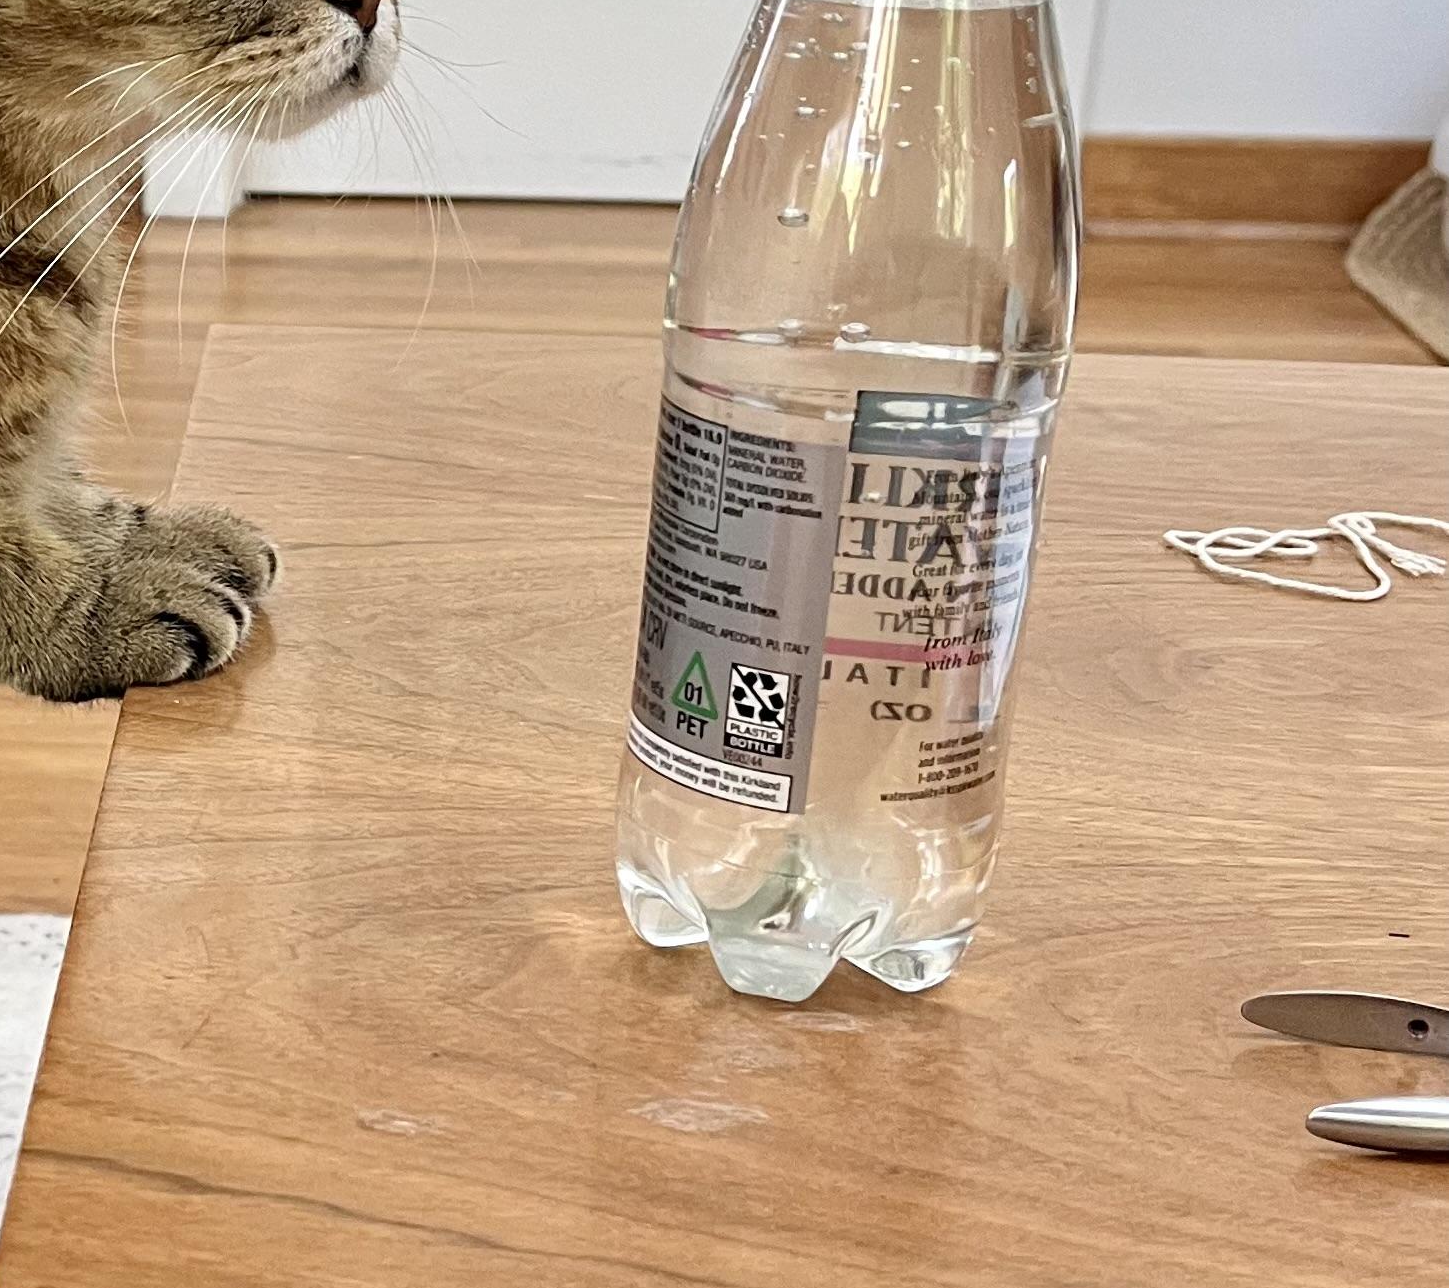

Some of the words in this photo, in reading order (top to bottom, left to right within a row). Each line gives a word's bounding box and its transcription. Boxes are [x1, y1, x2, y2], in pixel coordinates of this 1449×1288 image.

[912, 563, 947, 578] Great
[782, 641, 811, 656] ITALY
[924, 633, 967, 653] from
[925, 654, 963, 672] with
[684, 681, 703, 706] 01
[676, 711, 709, 739] PET
[730, 722, 779, 741] PLASTIC
[729, 735, 775, 754] BOTTLE
[741, 773, 781, 792] Kirkland
[732, 785, 778, 803] refunded.
